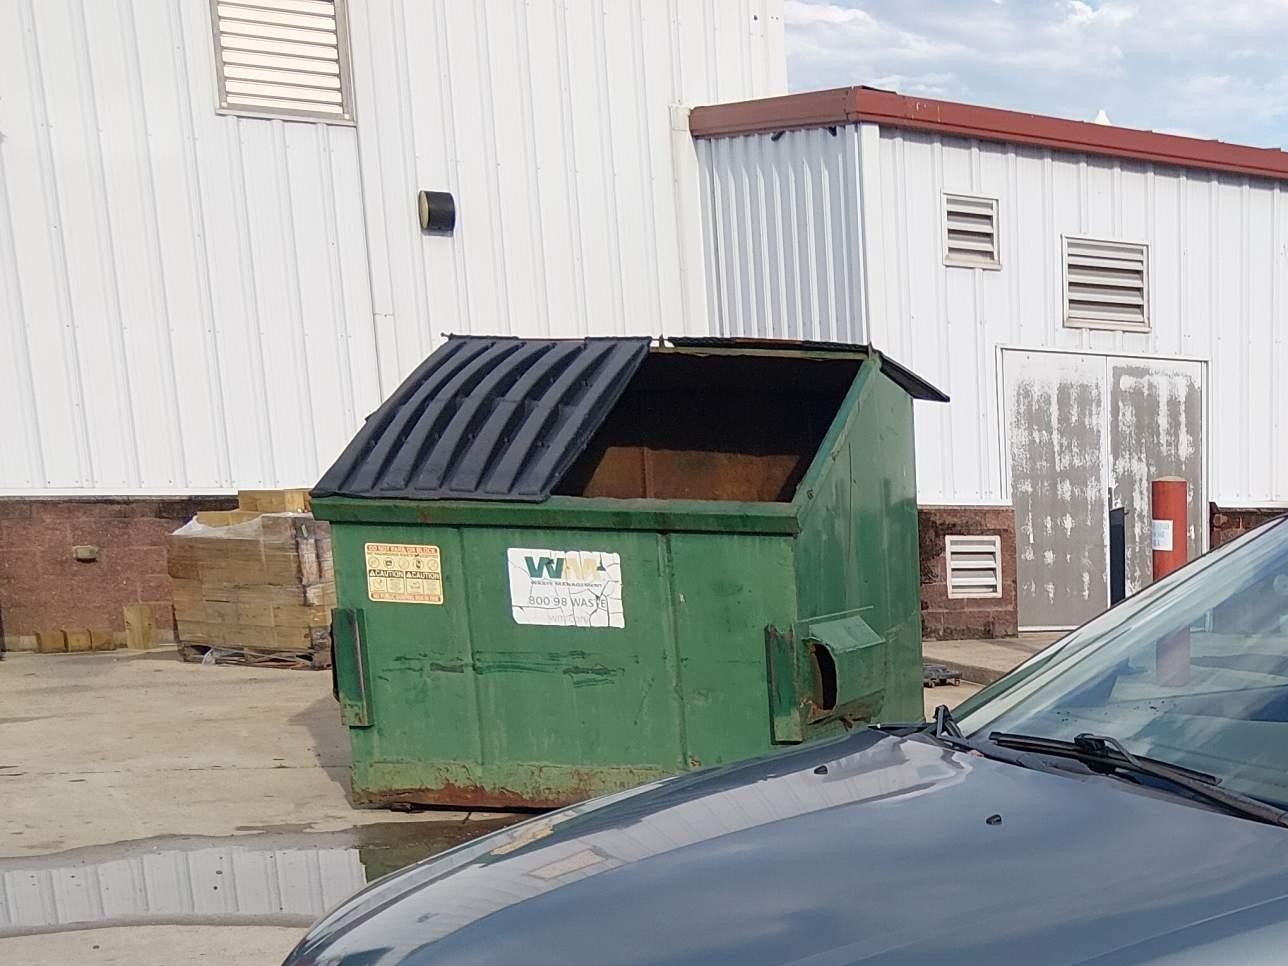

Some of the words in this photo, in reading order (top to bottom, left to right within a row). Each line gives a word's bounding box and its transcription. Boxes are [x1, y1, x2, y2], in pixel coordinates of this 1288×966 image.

[376, 570, 404, 578] CAUTION
[413, 571, 440, 580] CAUTION
[528, 596, 550, 606] 800
[553, 597, 568, 606] 98
[571, 598, 607, 608] WASTE
